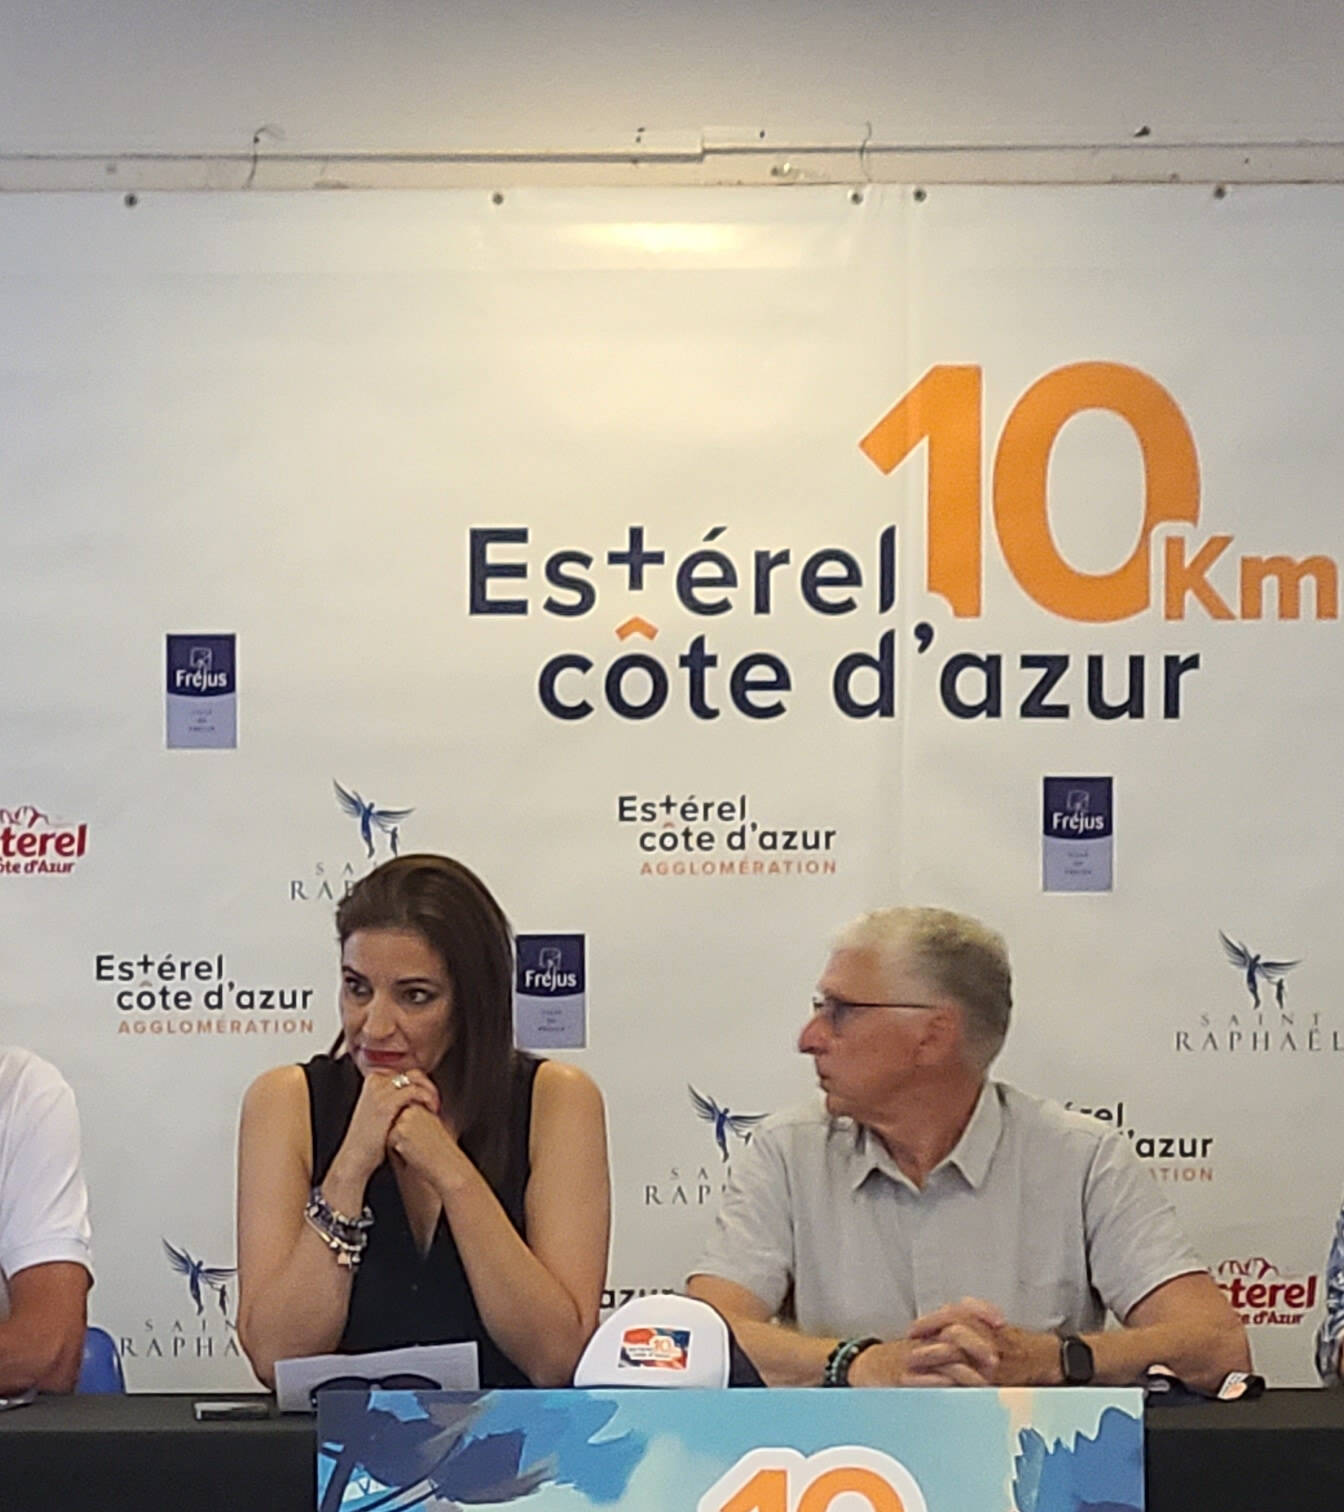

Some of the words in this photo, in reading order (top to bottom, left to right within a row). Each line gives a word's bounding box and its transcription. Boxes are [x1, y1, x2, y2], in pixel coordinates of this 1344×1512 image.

[859, 361, 1201, 622] 10
[1165, 536, 1339, 621] Km
[539, 616, 792, 720] côte
[832, 622, 1201, 720] d'azur
[176, 669, 227, 692] Fréjus
[1052, 812, 1104, 834] Fréjus
[639, 822, 715, 851] côte
[726, 822, 836, 851] d'azur
[24, 859, 75, 874] d'Azur
[640, 855, 837, 875] AGGLOMÉRATION
[525, 969, 577, 992] Fréjus
[116, 981, 193, 1010] côte
[204, 981, 313, 1010] d'azur
[118, 1014, 314, 1034] AGGLOMÉRATION
[1200, 1012, 1321, 1027] SAINT
[1127, 1129, 1213, 1158] 'azur
[670, 1166, 731, 1180] SAI
[1218, 1275, 1317, 1309] terel
[144, 1319, 237, 1332] SAIN
[1253, 1311, 1303, 1325] d'Azur
[120, 1336, 240, 1357] RAPHA
